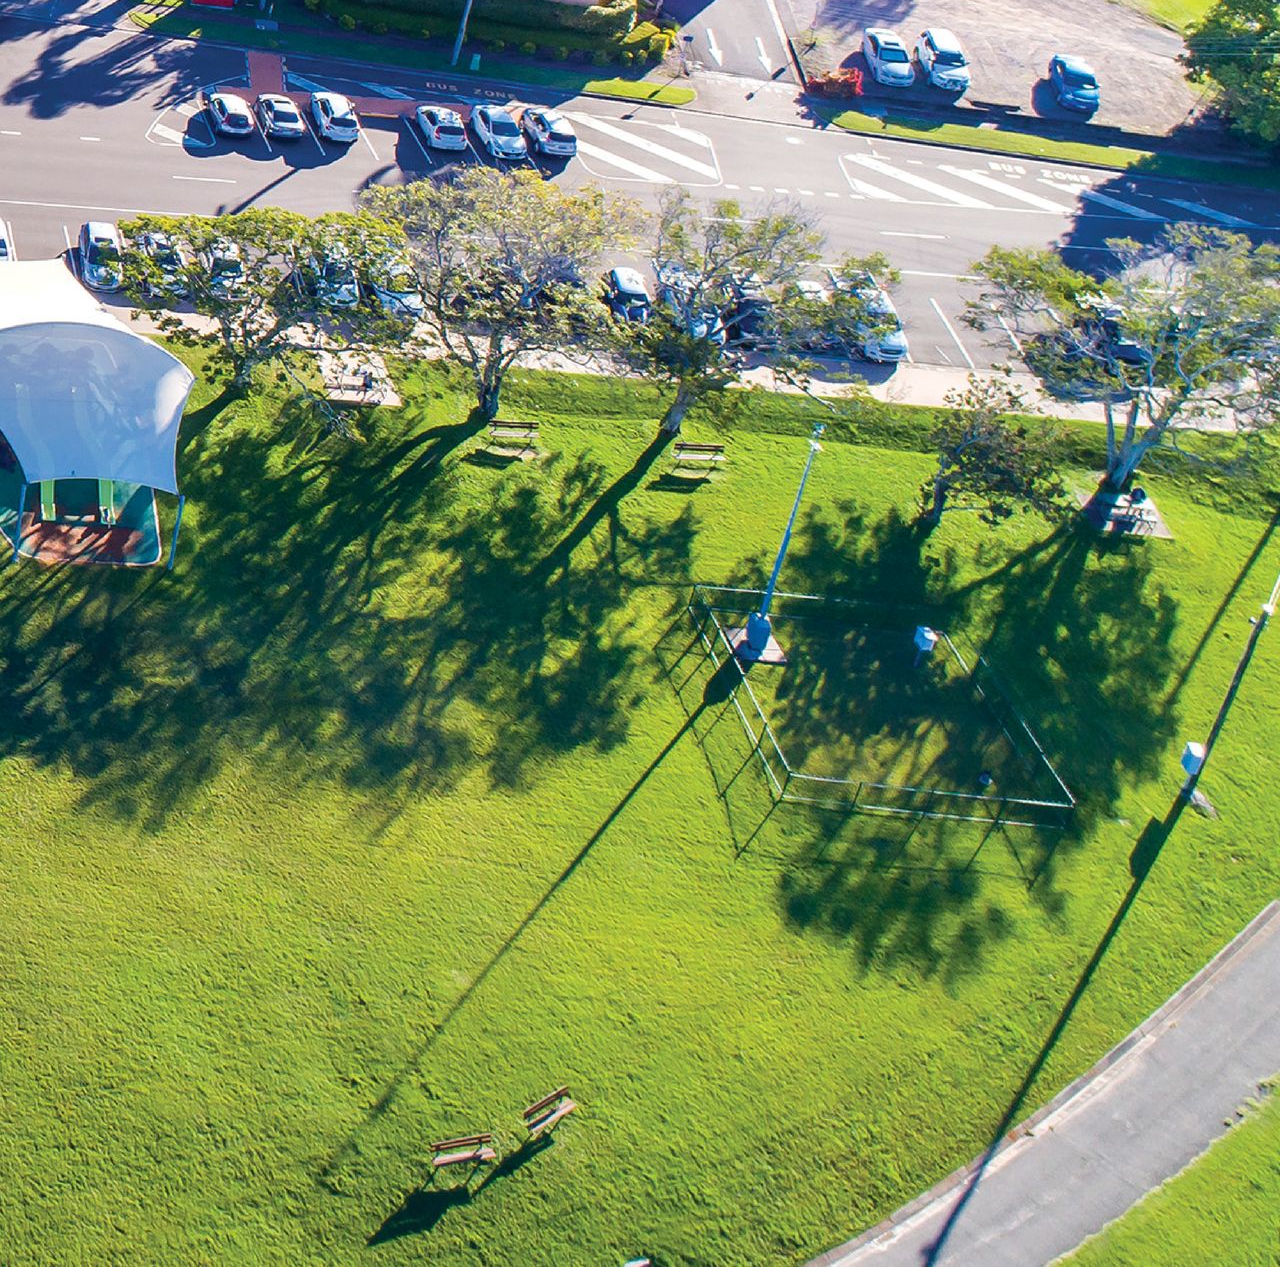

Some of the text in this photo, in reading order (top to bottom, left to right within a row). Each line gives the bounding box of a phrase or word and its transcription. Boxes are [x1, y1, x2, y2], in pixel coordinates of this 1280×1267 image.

[425, 81, 517, 100] BUS ZONE
[988, 161, 1093, 183] BUS ZONE
